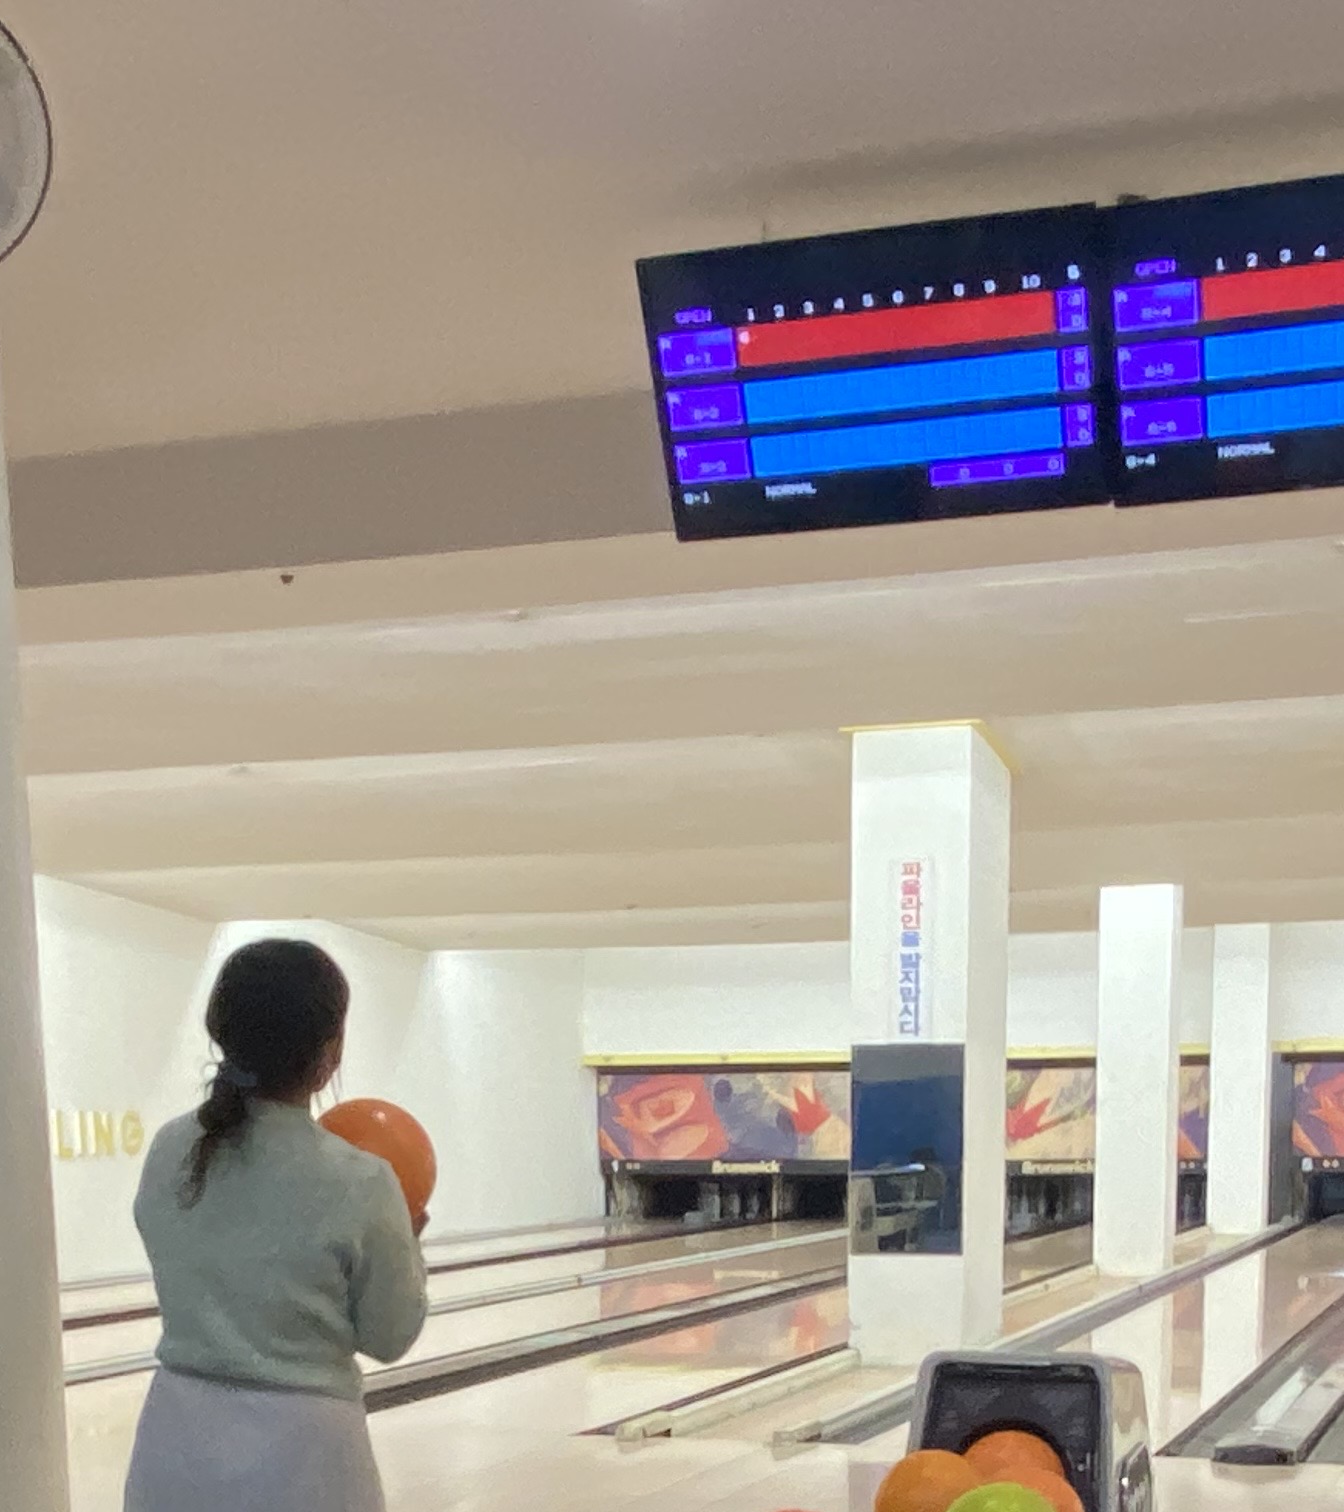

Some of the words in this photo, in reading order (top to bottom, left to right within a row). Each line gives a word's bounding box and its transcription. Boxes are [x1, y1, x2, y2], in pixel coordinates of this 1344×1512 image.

[1247, 253, 1258, 268] 2
[1314, 245, 1326, 258] 4
[773, 304, 785, 318] 2
[833, 298, 845, 310] 4
[924, 286, 934, 300] 7
[1022, 274, 1041, 289] 10
